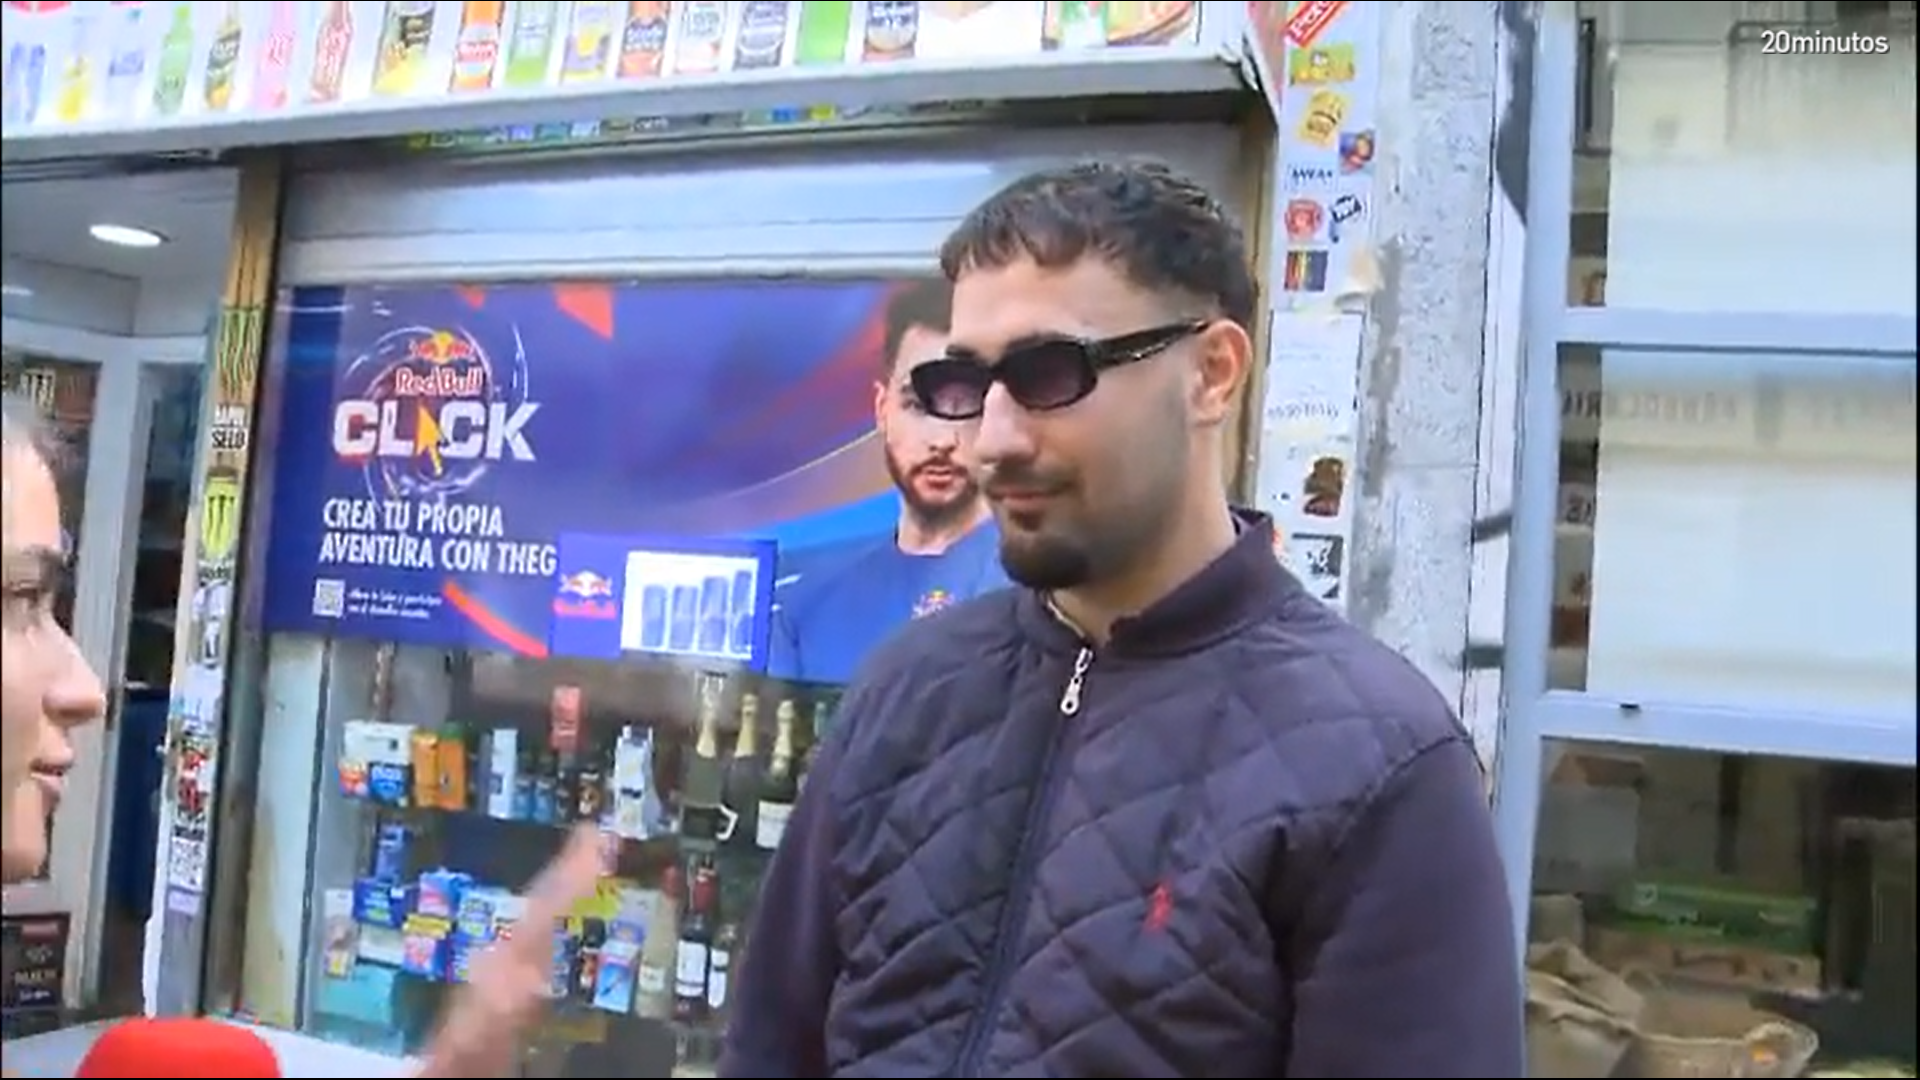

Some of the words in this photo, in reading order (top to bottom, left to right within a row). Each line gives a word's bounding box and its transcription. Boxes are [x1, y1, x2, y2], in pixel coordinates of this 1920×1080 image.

[332, 400, 541, 461] CLCK
[323, 498, 376, 530] CREA
[383, 500, 411, 531] TU
[417, 503, 503, 536] PROPIA
[319, 532, 434, 569] AVENTURA
[441, 538, 490, 571] CON
